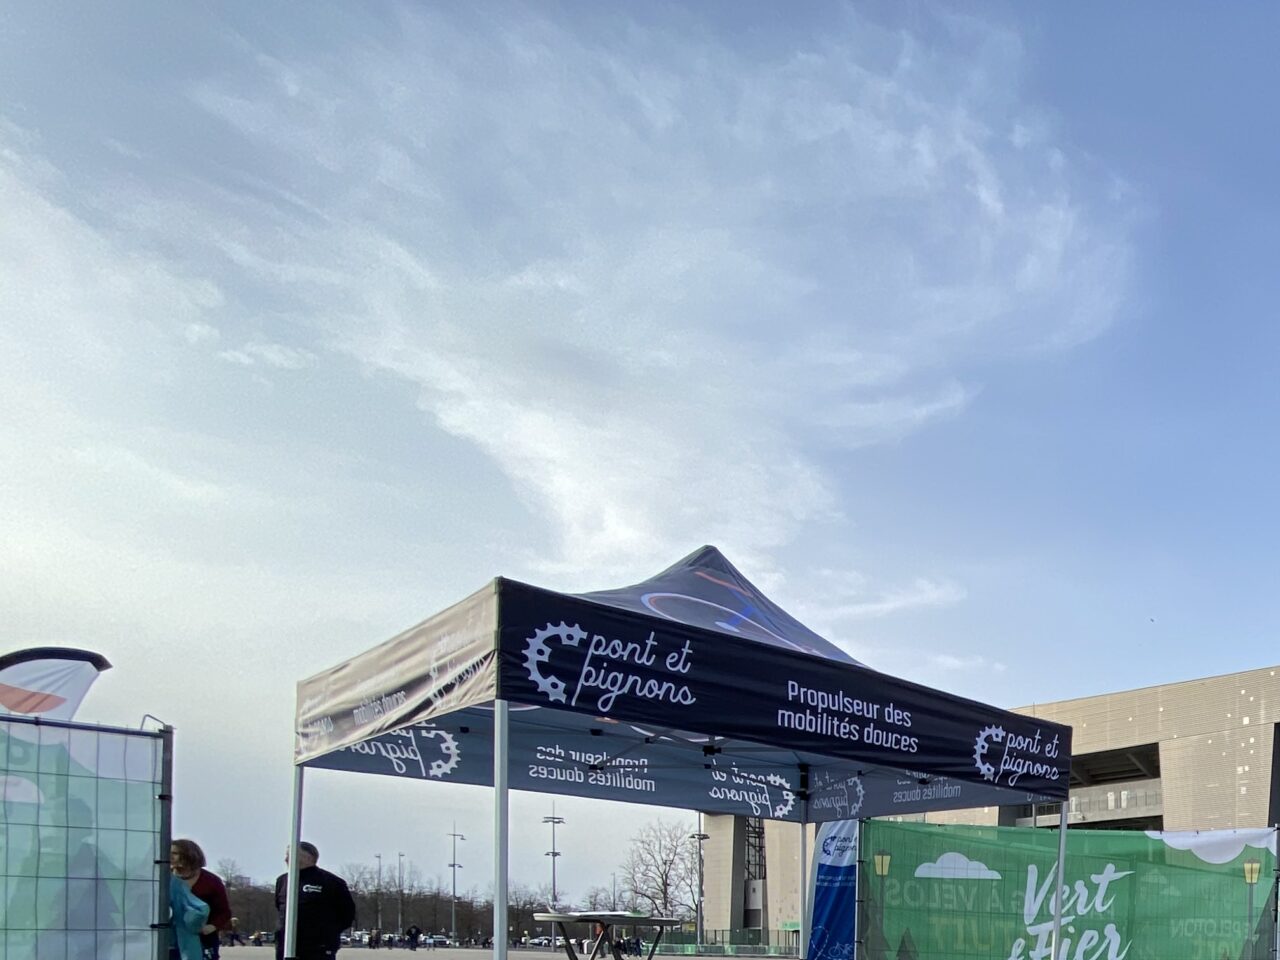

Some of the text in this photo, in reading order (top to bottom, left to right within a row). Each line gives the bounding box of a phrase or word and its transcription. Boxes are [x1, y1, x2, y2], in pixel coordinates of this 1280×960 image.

[585, 631, 693, 673] pont et
[571, 661, 697, 712] pignons
[787, 680, 912, 727] Propulseur des
[777, 709, 919, 753] mobilités douces
[1003, 728, 1060, 758] pont et
[994, 752, 1060, 787] pignons
[1024, 860, 1136, 925] Vert
